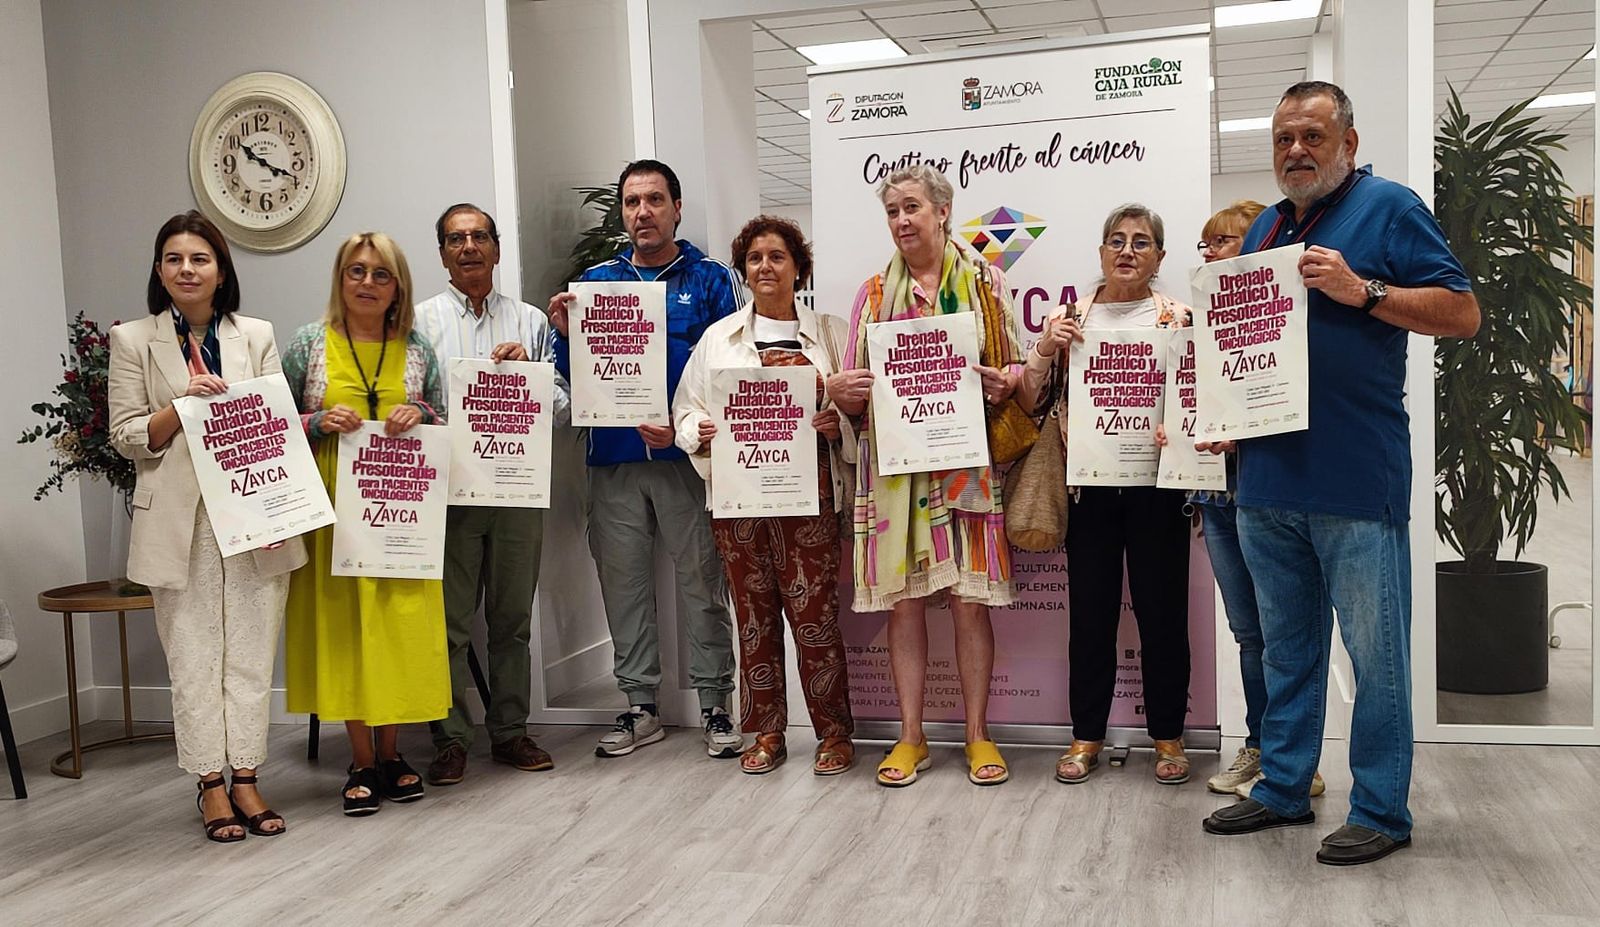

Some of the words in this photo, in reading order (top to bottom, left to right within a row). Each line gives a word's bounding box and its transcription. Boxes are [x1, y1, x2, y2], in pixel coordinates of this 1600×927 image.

[983, 81, 1043, 99] ZAMORA
[1095, 78, 1129, 92] CAJA
[1133, 73, 1182, 88] RURAL
[1109, 90, 1143, 100] ZAMORA
[851, 105, 908, 121] ZAMORA
[241, 122, 250, 137] 11
[253, 113, 270, 132] 12
[279, 121, 283, 135] 1
[229, 135, 240, 150] 10
[287, 131, 296, 146] 2
[223, 154, 237, 175] 9
[291, 151, 305, 172] 3
[959, 142, 1027, 189] frente
[1035, 132, 1062, 168] al
[1069, 140, 1145, 165] cáncer
[231, 176, 240, 192] 8
[291, 175, 300, 190] 4
[244, 190, 252, 204] 7
[259, 192, 273, 211] 6
[279, 188, 288, 203] 5
[1219, 266, 1274, 293] Drenaje
[1270, 283, 1279, 299] y
[593, 293, 640, 308] Drenaje
[636, 309, 643, 321] y
[1207, 296, 1293, 327] Presoterapia
[581, 319, 654, 334] Presoterapia
[1214, 326, 1235, 341] para
[1237, 314, 1286, 335] PACIENTES
[587, 336, 606, 346] para
[607, 334, 649, 345] PACIENTES
[896, 329, 948, 348] Drenaje
[945, 344, 953, 357] y
[1098, 341, 1153, 357] Drenaje
[593, 356, 641, 380] AZAYCA
[884, 354, 967, 376] Presoterapia
[1149, 358, 1157, 371] y
[1222, 350, 1277, 382] AZAYCA
[476, 371, 526, 387] Drenaje
[892, 377, 913, 388] para
[914, 370, 961, 385] PACIENTES
[1084, 369, 1166, 386] Presoterapia
[737, 378, 788, 394] Drenaje
[1090, 387, 1112, 398] para
[1113, 385, 1162, 397] PACIENTES
[522, 389, 530, 401] y
[784, 394, 792, 406] y
[209, 393, 264, 419] Drenaje
[462, 396, 541, 414] Presoterapia
[724, 404, 804, 420] Presoterapia
[901, 397, 955, 423] AZAYCA
[262, 407, 274, 421] y
[468, 413, 488, 424] para
[490, 413, 535, 425] PACIENTES
[1096, 409, 1150, 435] AZAYCA
[202, 417, 289, 450] Presoterapia
[730, 423, 751, 433] para
[752, 420, 798, 431] PACIENTES
[214, 448, 237, 462] para
[236, 433, 286, 455] PACIENTES
[368, 433, 422, 452] Drenaje
[473, 434, 525, 459] AZAYCA
[417, 454, 426, 466] y
[737, 443, 790, 469] AZAYCA
[352, 460, 436, 480] Presoterapia
[231, 466, 288, 496] AZAYCA
[358, 479, 380, 490] para
[381, 478, 429, 492] PACIENTES
[362, 501, 418, 527] AZAYCA
